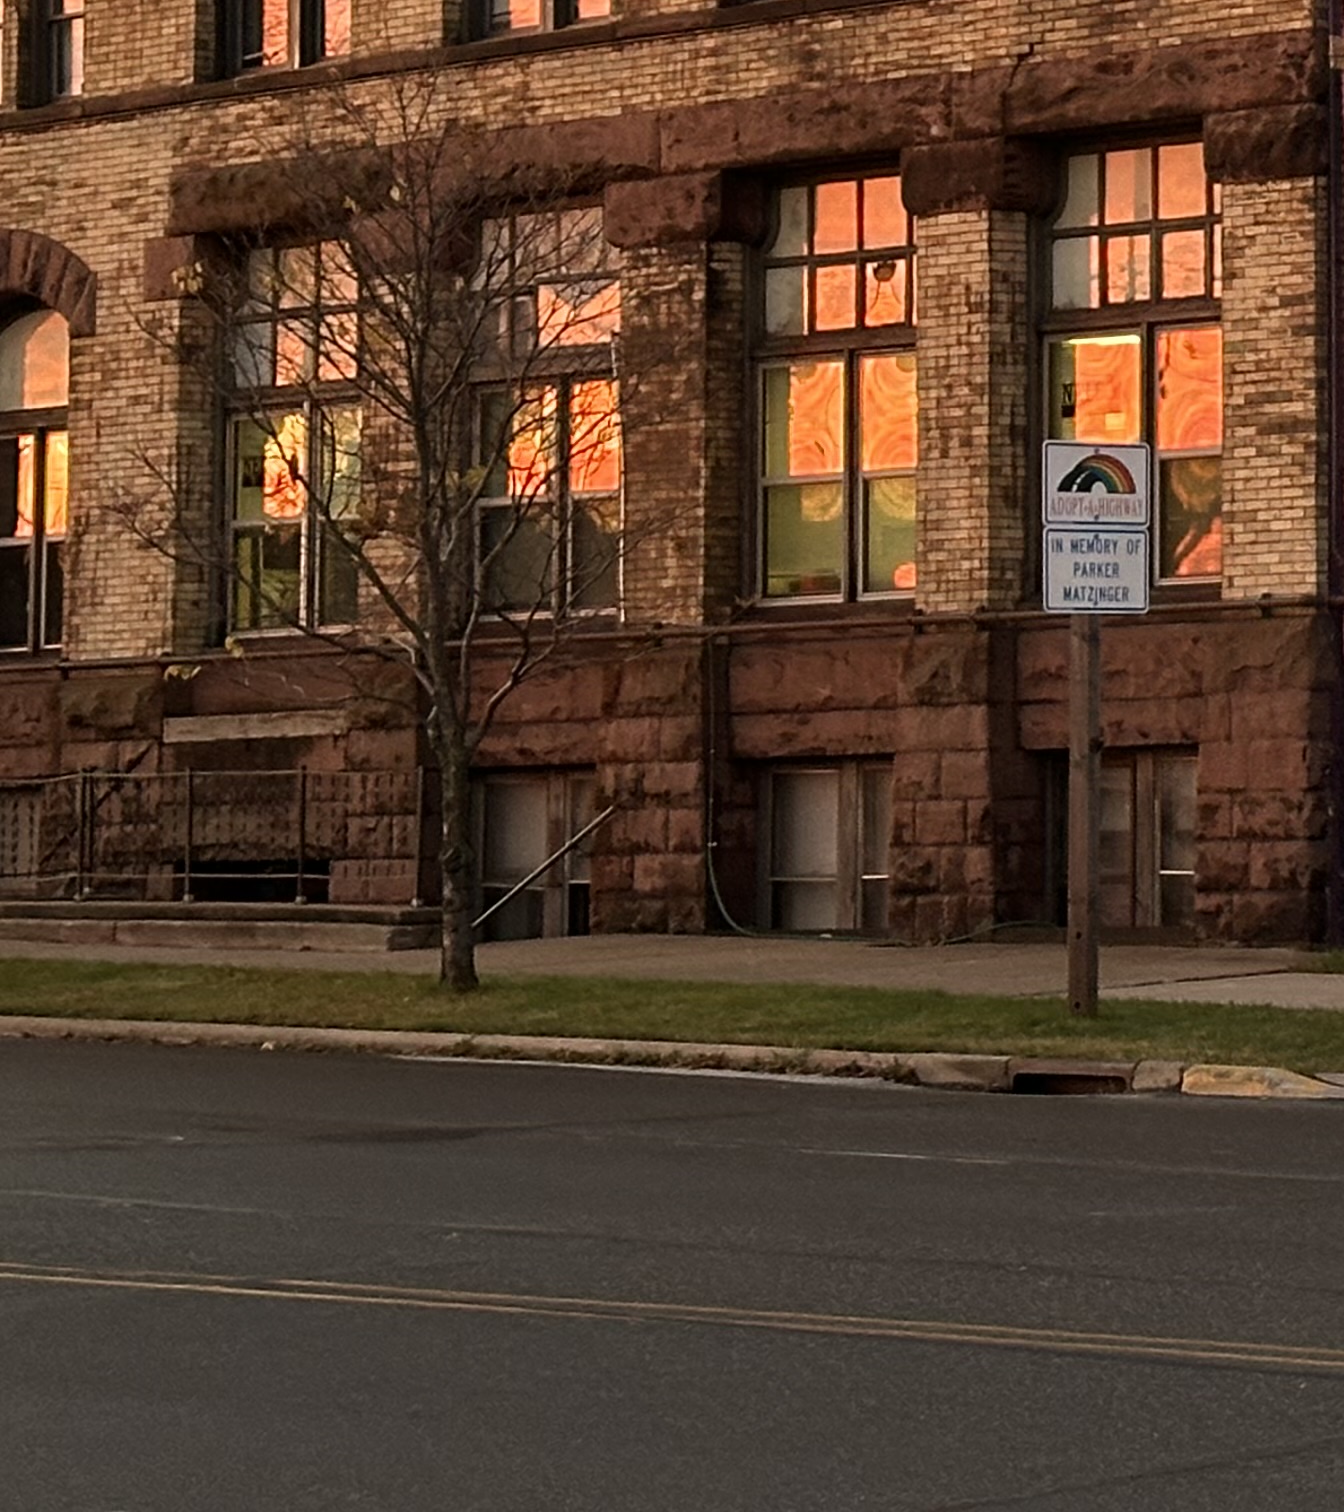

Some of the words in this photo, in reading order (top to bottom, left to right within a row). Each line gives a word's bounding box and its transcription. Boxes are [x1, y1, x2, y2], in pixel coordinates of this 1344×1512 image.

[1051, 537, 1063, 553] IN
[1070, 538, 1118, 555] MEMORY
[1127, 539, 1142, 555] OF
[1073, 562, 1120, 579] PARKER
[1063, 585, 1129, 602] MATZINGER
